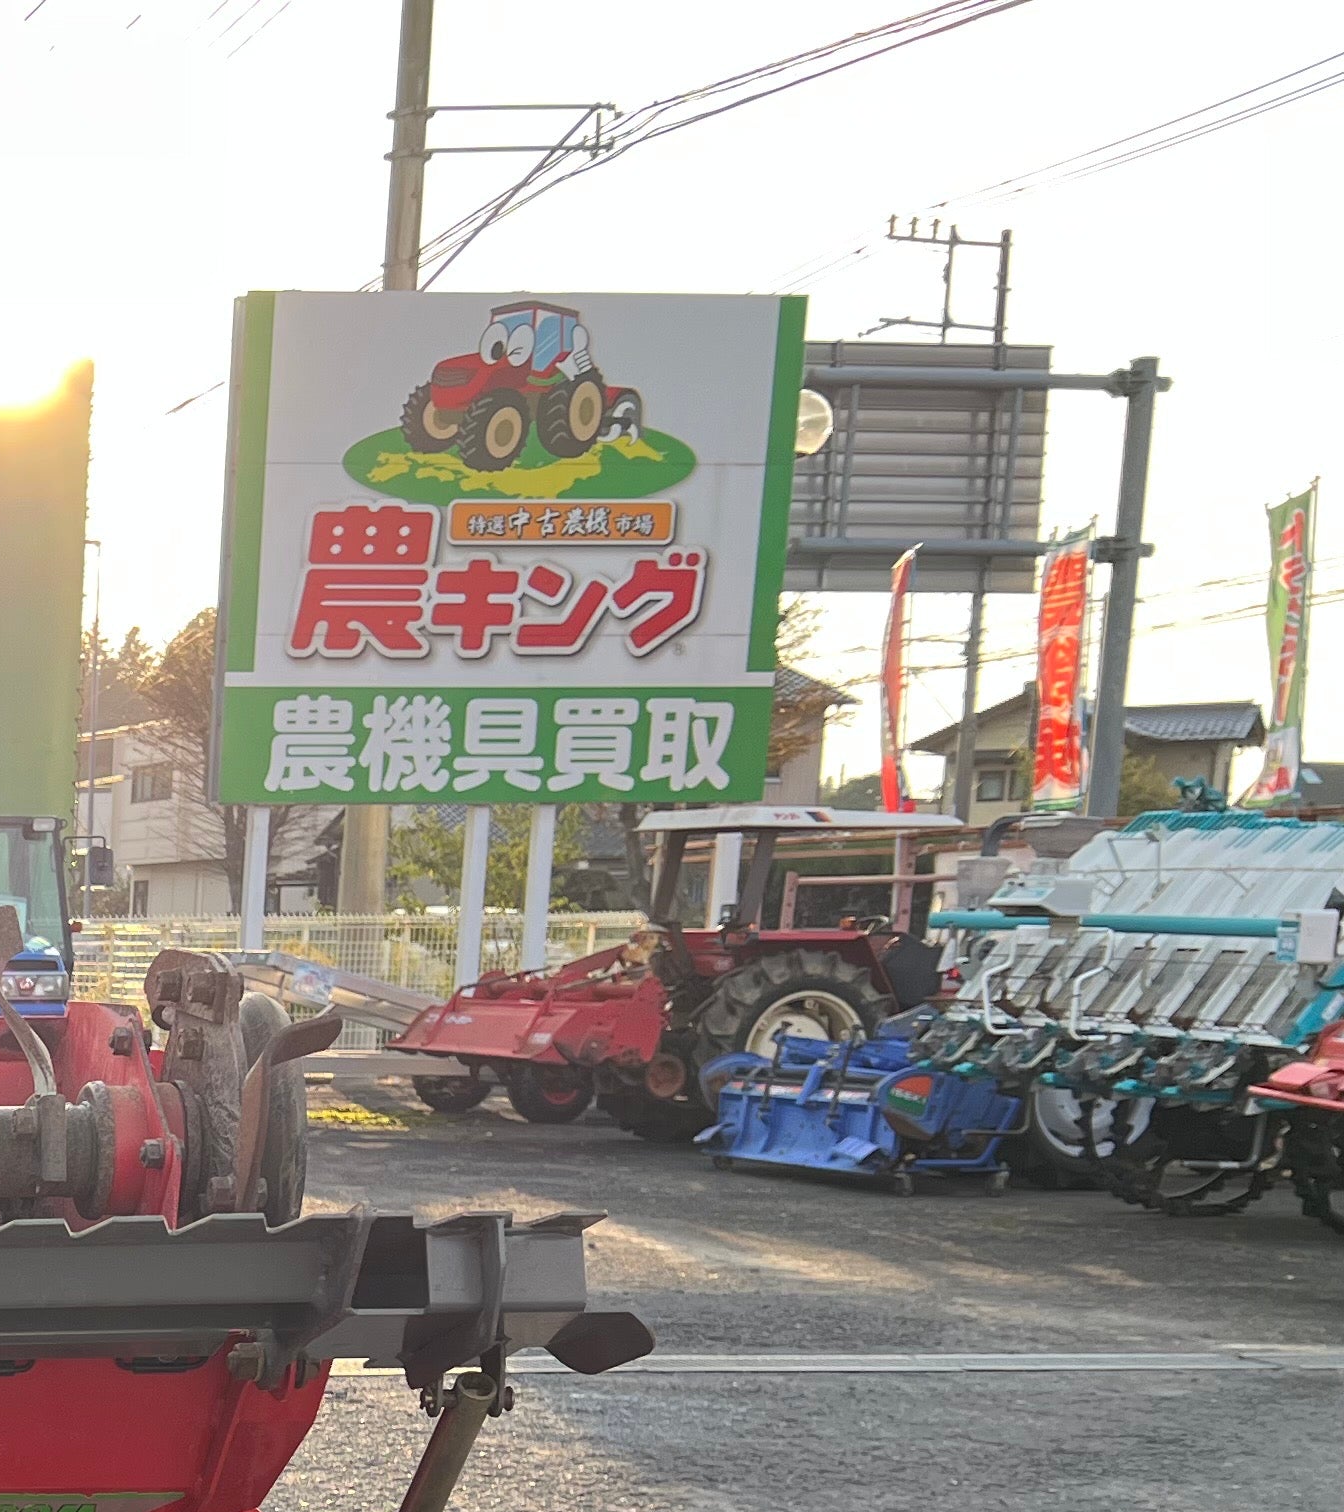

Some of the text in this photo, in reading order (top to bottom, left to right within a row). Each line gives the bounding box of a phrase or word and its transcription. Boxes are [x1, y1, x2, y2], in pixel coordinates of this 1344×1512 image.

[467, 506, 654, 538] 特選中古農機市場
[289, 503, 701, 655] 農キング
[263, 692, 735, 793] 農機具買取
